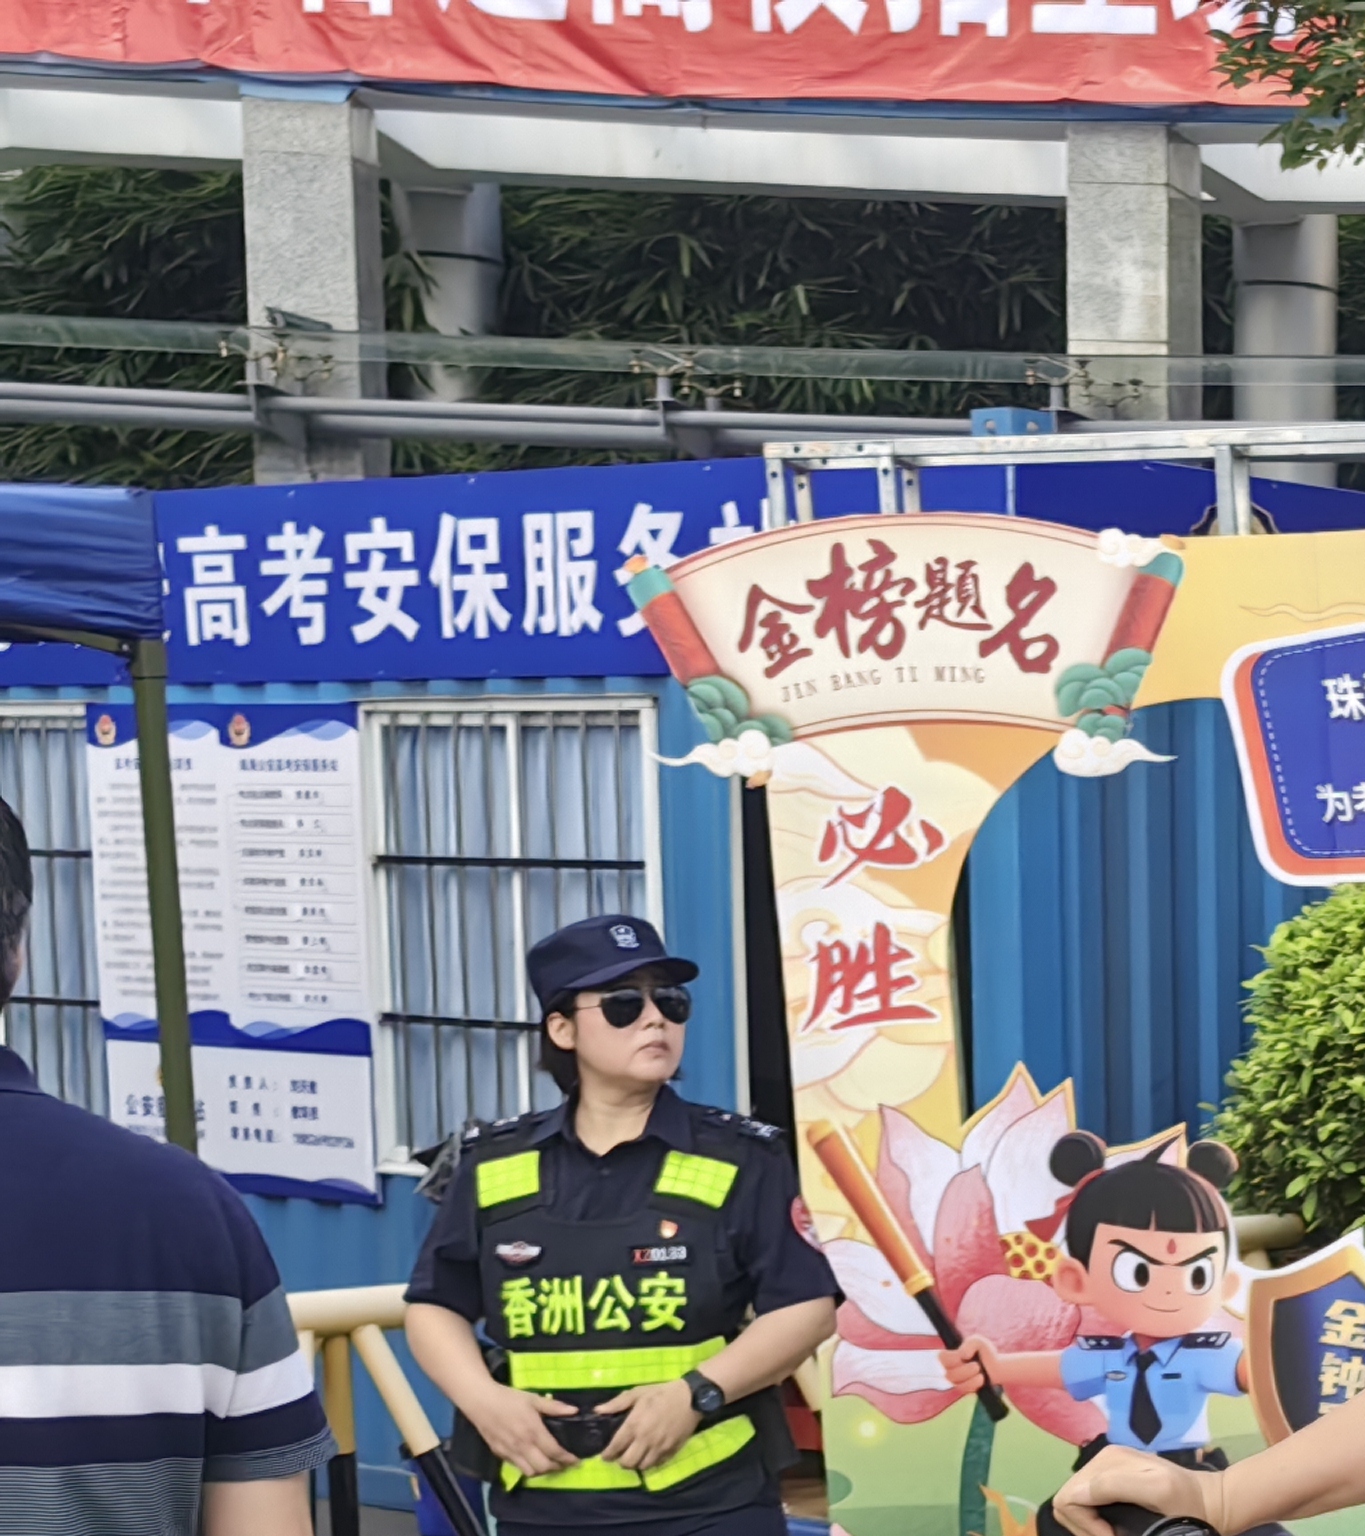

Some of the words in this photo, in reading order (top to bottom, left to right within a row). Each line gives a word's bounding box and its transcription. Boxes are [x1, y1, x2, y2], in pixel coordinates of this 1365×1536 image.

[160, 501, 758, 646] 高考安保服务
[781, 679, 818, 703] JIN
[830, 669, 882, 691] BANG
[895, 666, 919, 683] TI
[934, 666, 986, 683] MING
[803, 786, 945, 1033] 必胜
[501, 1271, 688, 1339] 香洲公安
